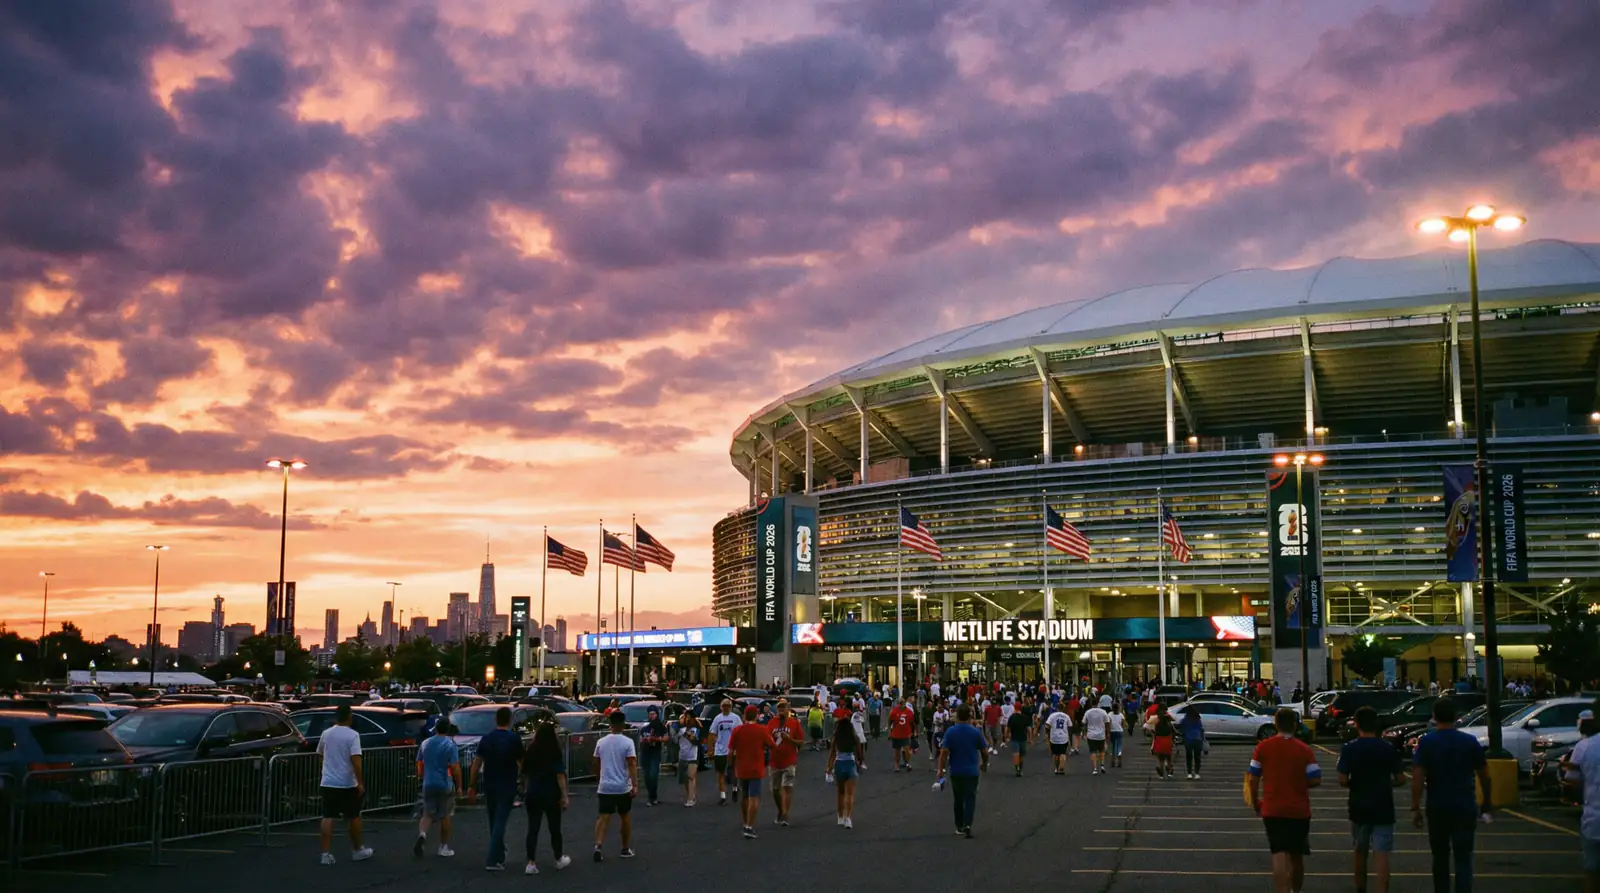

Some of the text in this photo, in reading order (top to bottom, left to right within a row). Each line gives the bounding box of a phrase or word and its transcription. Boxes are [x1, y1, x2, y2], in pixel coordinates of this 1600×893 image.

[1502, 474, 1518, 571] FIFA WORLD CUP 2026
[765, 524, 776, 621] FIFA WORLD CUP 2026
[943, 619, 1094, 641] METLIFE STADIUM
